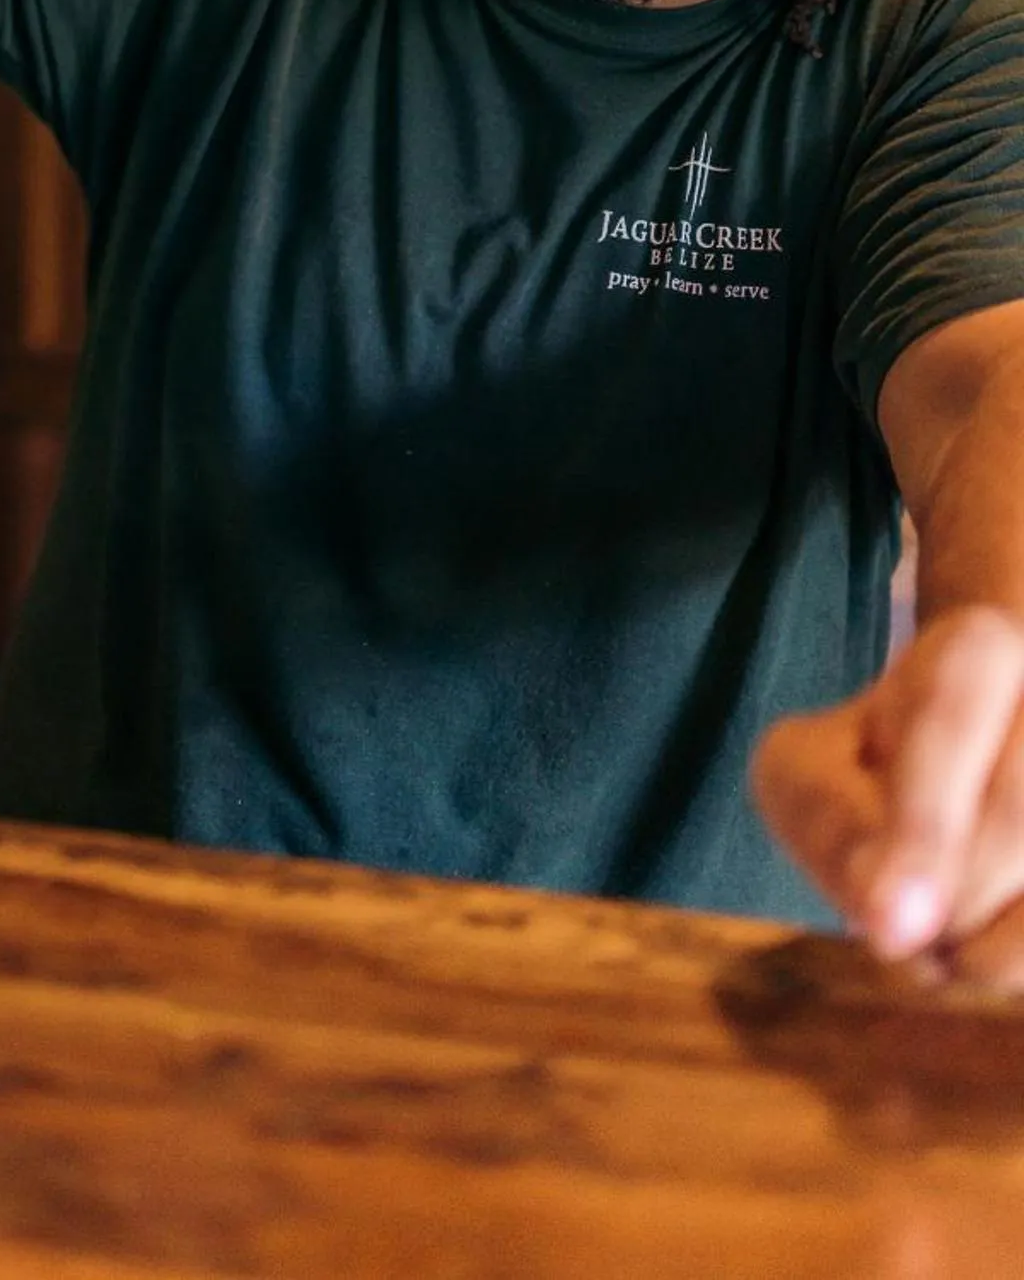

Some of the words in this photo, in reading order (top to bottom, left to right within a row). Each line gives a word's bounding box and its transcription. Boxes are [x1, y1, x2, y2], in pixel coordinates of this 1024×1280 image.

[649, 246, 735, 271] BELIZE
[607, 271, 651, 295] pray
[664, 270, 703, 296] learn
[724, 284, 770, 300] serve
